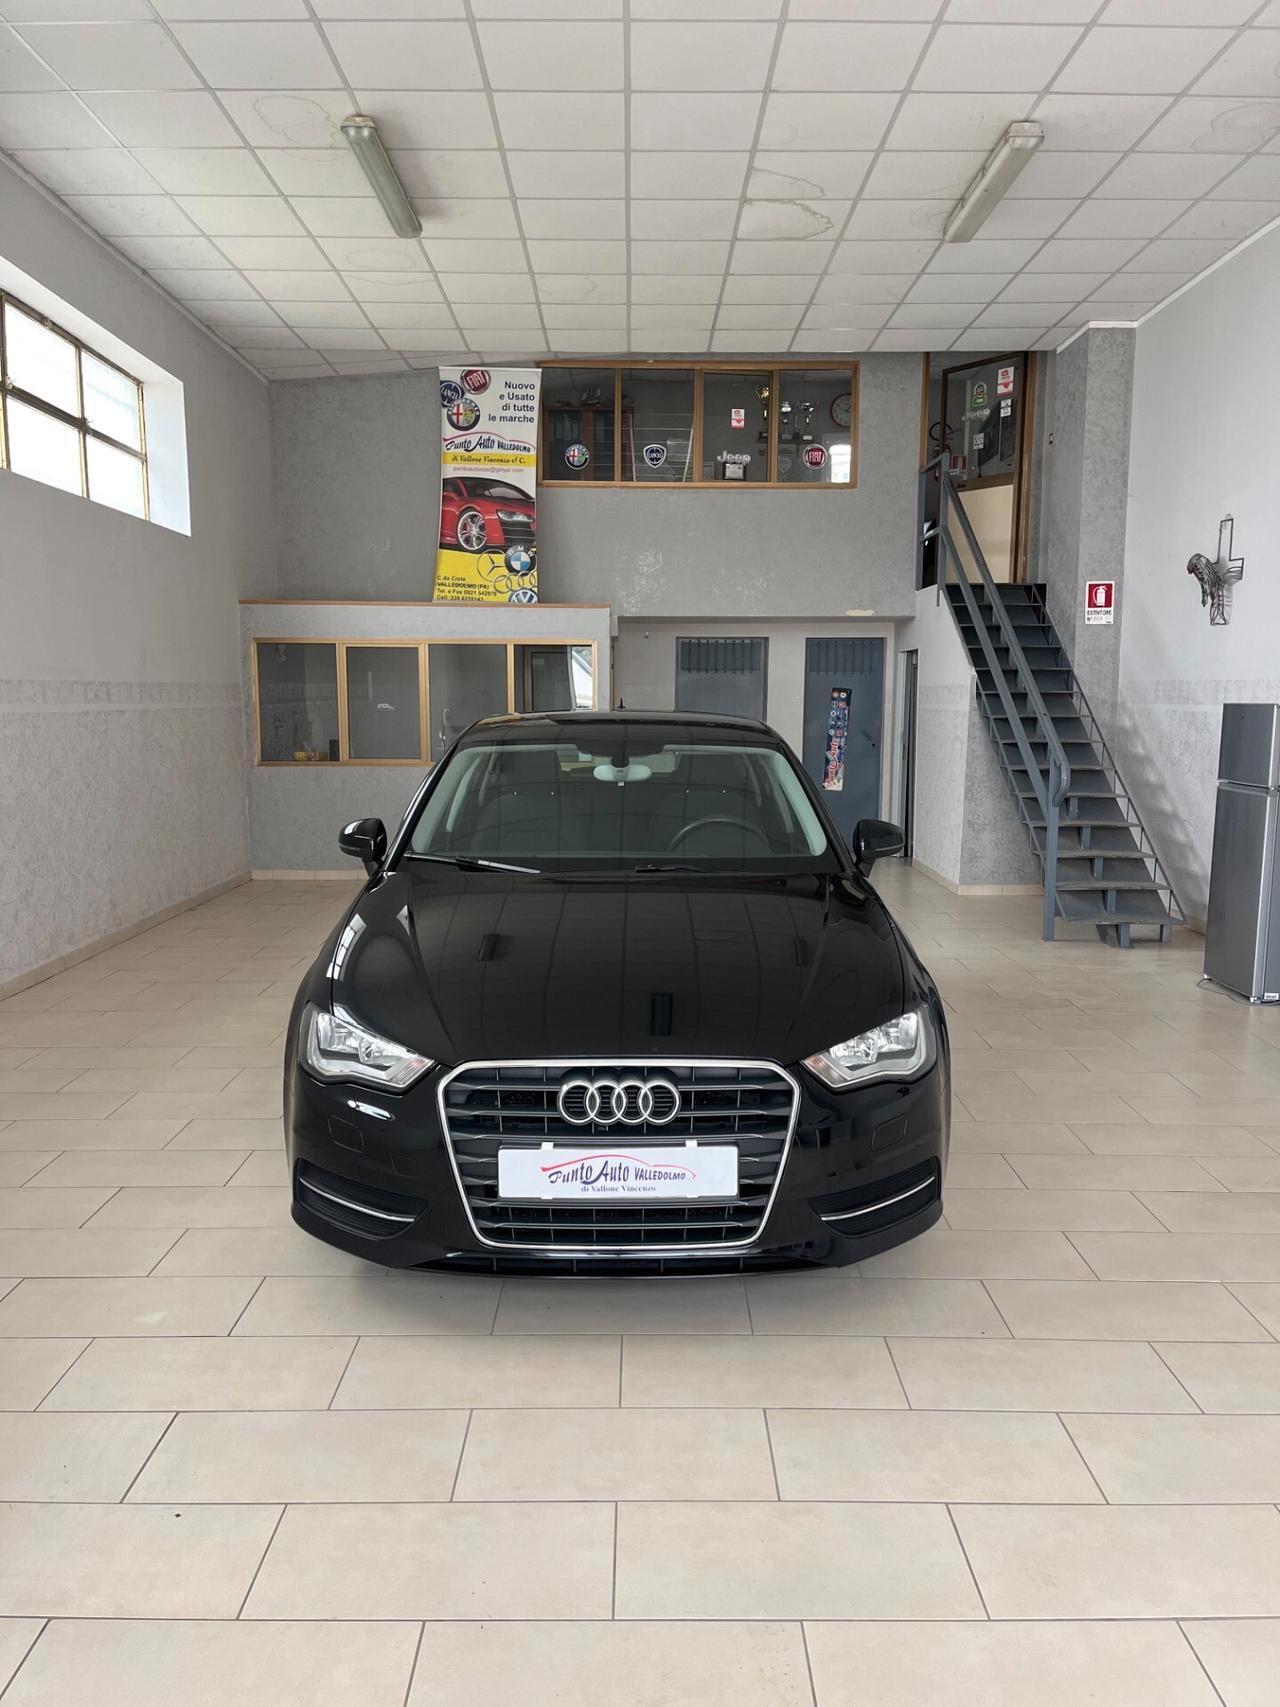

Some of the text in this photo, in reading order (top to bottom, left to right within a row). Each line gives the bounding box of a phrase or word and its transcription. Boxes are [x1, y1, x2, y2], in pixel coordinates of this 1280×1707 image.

[466, 372, 486, 388] FIAT
[504, 381, 536, 390] Nuovo
[507, 392, 535, 401] Usato
[502, 402, 535, 412] di tutte
[488, 413, 535, 423] le marche
[445, 435, 531, 453] Punto Auto VALLEDOLMO
[459, 455, 482, 463] Vallone
[483, 456, 510, 464] Vincenzo
[717, 450, 751, 465] Jeep
[808, 451, 822, 463] FIAT
[548, 1160, 686, 1185] Punto Auto VALLEDOLMO
